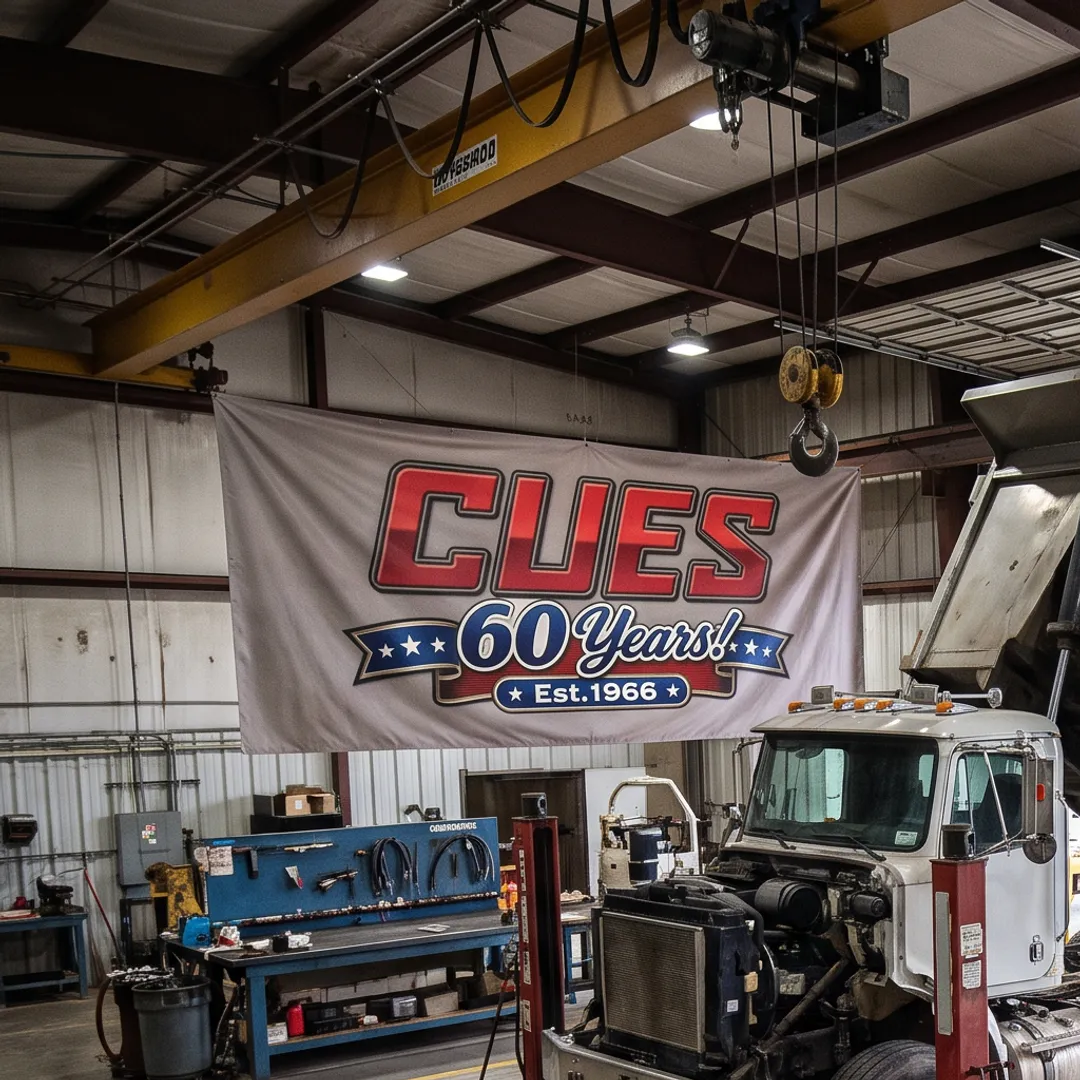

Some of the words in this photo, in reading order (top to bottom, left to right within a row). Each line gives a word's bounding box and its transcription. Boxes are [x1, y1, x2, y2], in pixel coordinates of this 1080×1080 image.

[369, 460, 779, 602] CUES
[457, 599, 570, 672] 60
[572, 602, 743, 678] Years!
[534, 681, 658, 704] Est.1966
